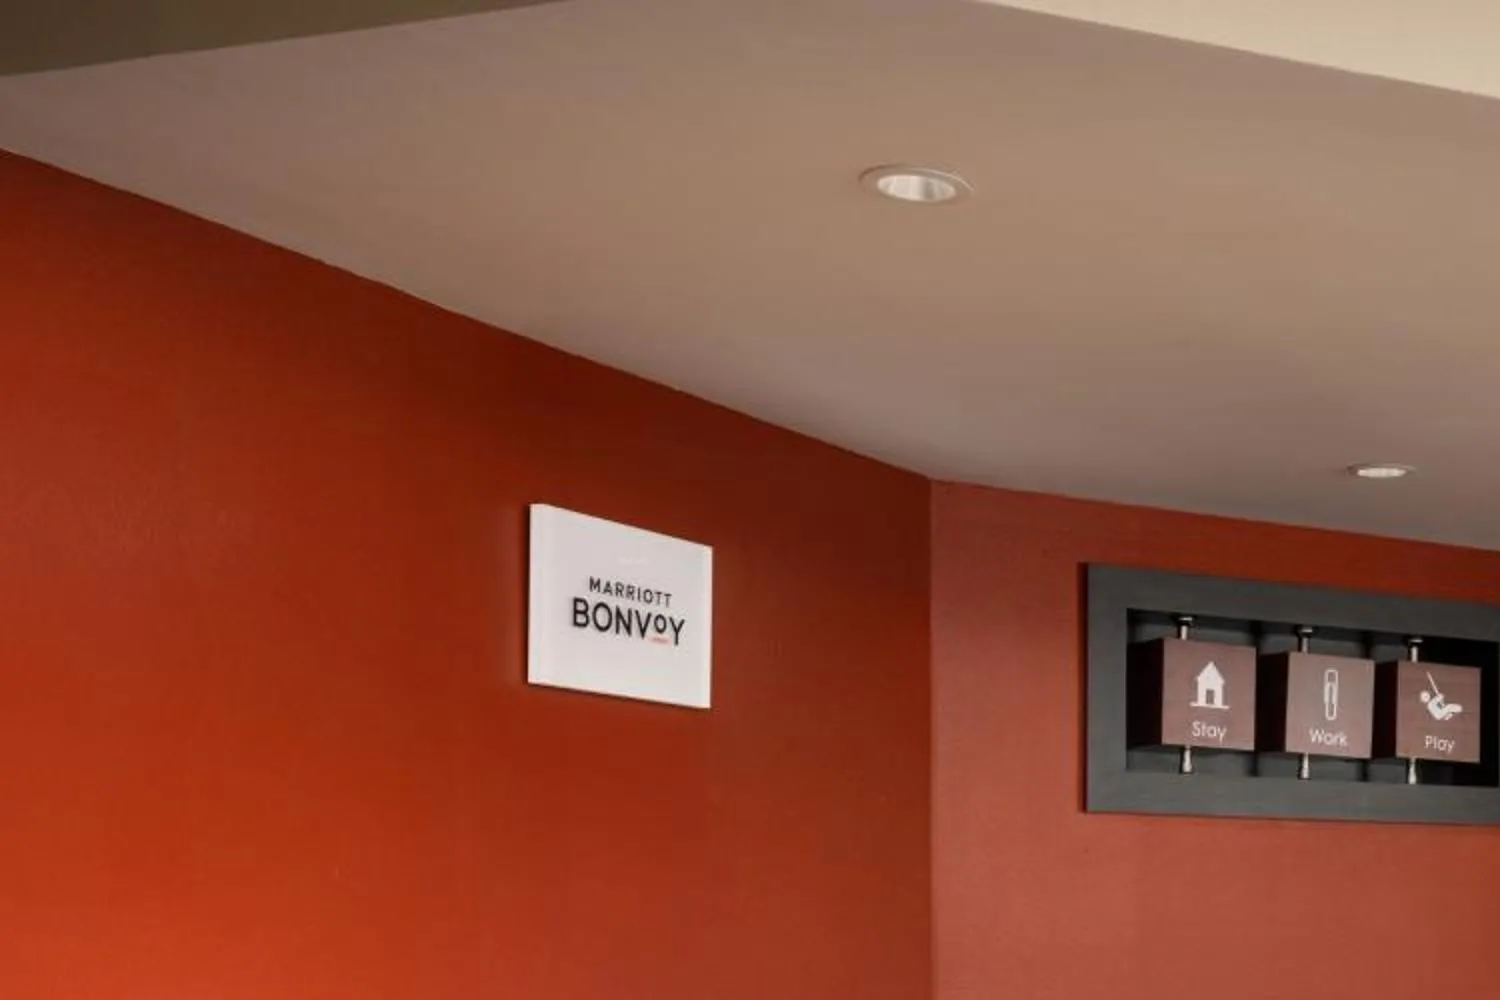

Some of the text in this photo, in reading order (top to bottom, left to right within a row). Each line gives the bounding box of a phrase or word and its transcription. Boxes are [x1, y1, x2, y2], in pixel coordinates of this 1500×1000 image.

[589, 576, 672, 608] MARRIOTT
[572, 597, 685, 646] BONVOY
[1191, 720, 1227, 741] Stay
[1309, 728, 1348, 747] Work
[1425, 735, 1455, 753] Play
